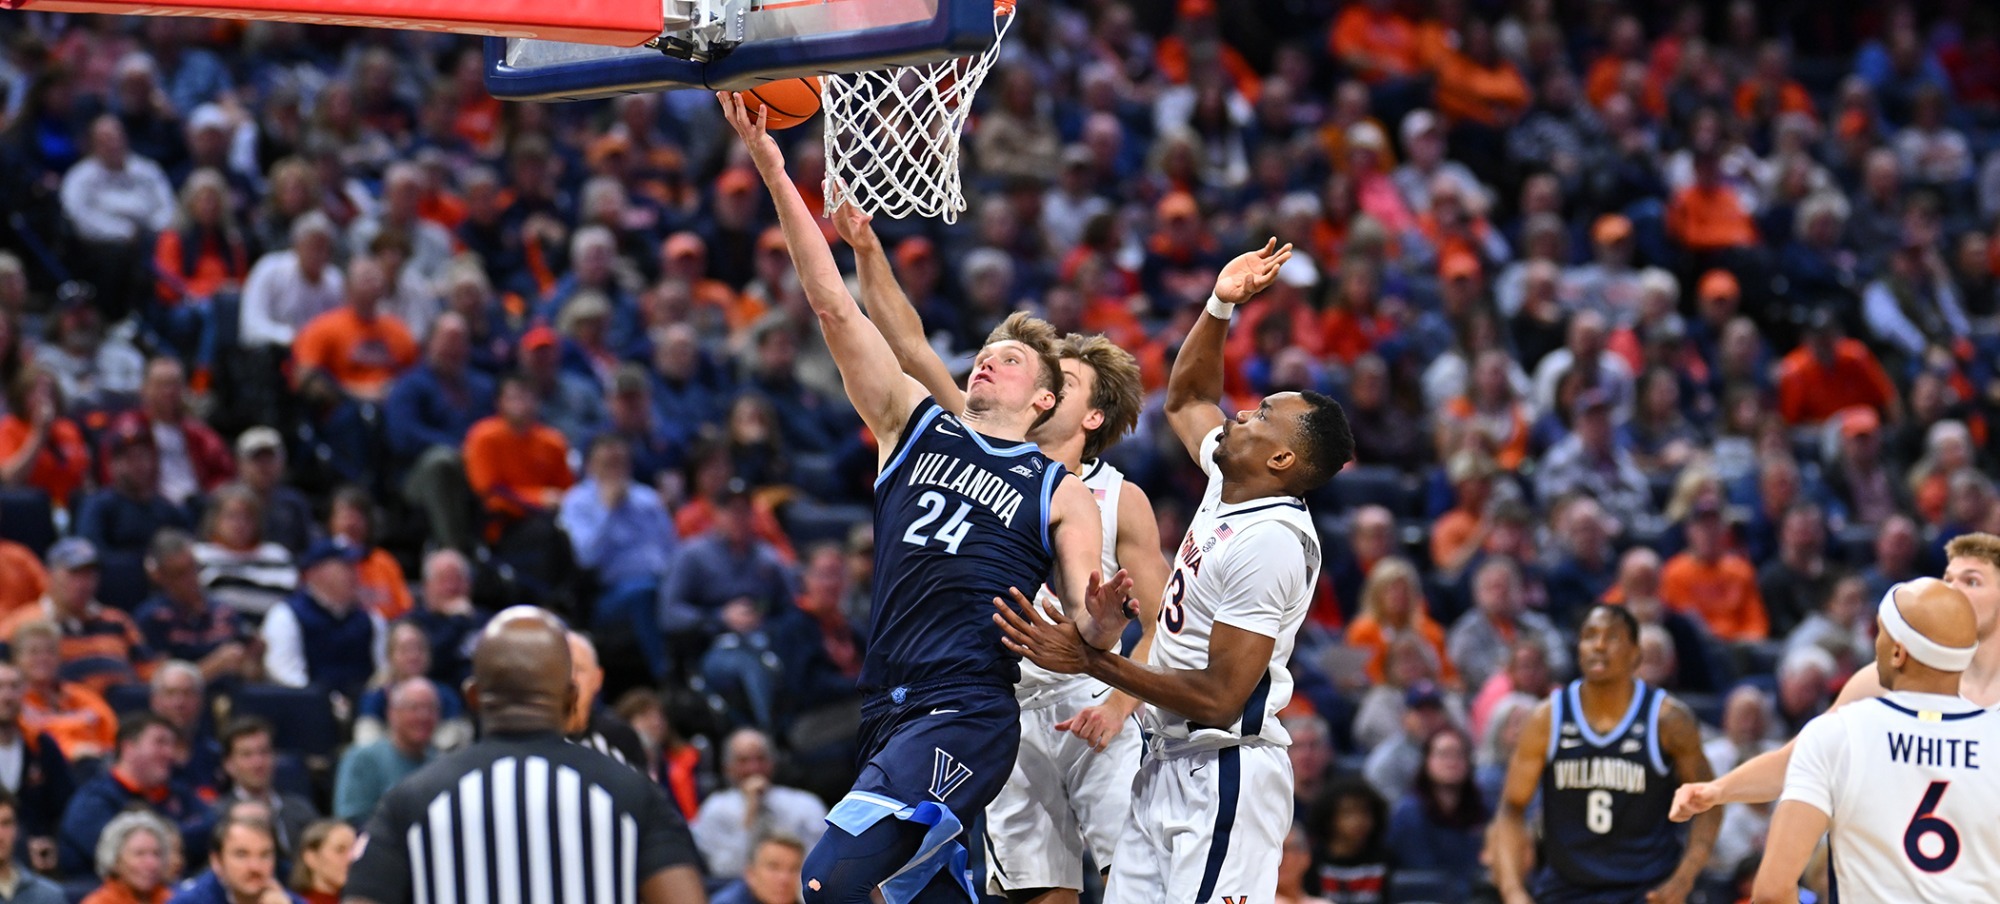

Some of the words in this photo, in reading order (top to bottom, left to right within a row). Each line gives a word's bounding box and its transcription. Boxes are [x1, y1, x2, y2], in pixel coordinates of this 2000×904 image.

[902, 490, 975, 555] 24
[908, 452, 1024, 529] VILLANOVA
[1157, 568, 1185, 635] 3
[1553, 756, 1647, 795] VILLANOVA
[1887, 731, 1980, 770] WHITE
[1586, 790, 1614, 835] 6
[1903, 780, 1961, 874] 6
